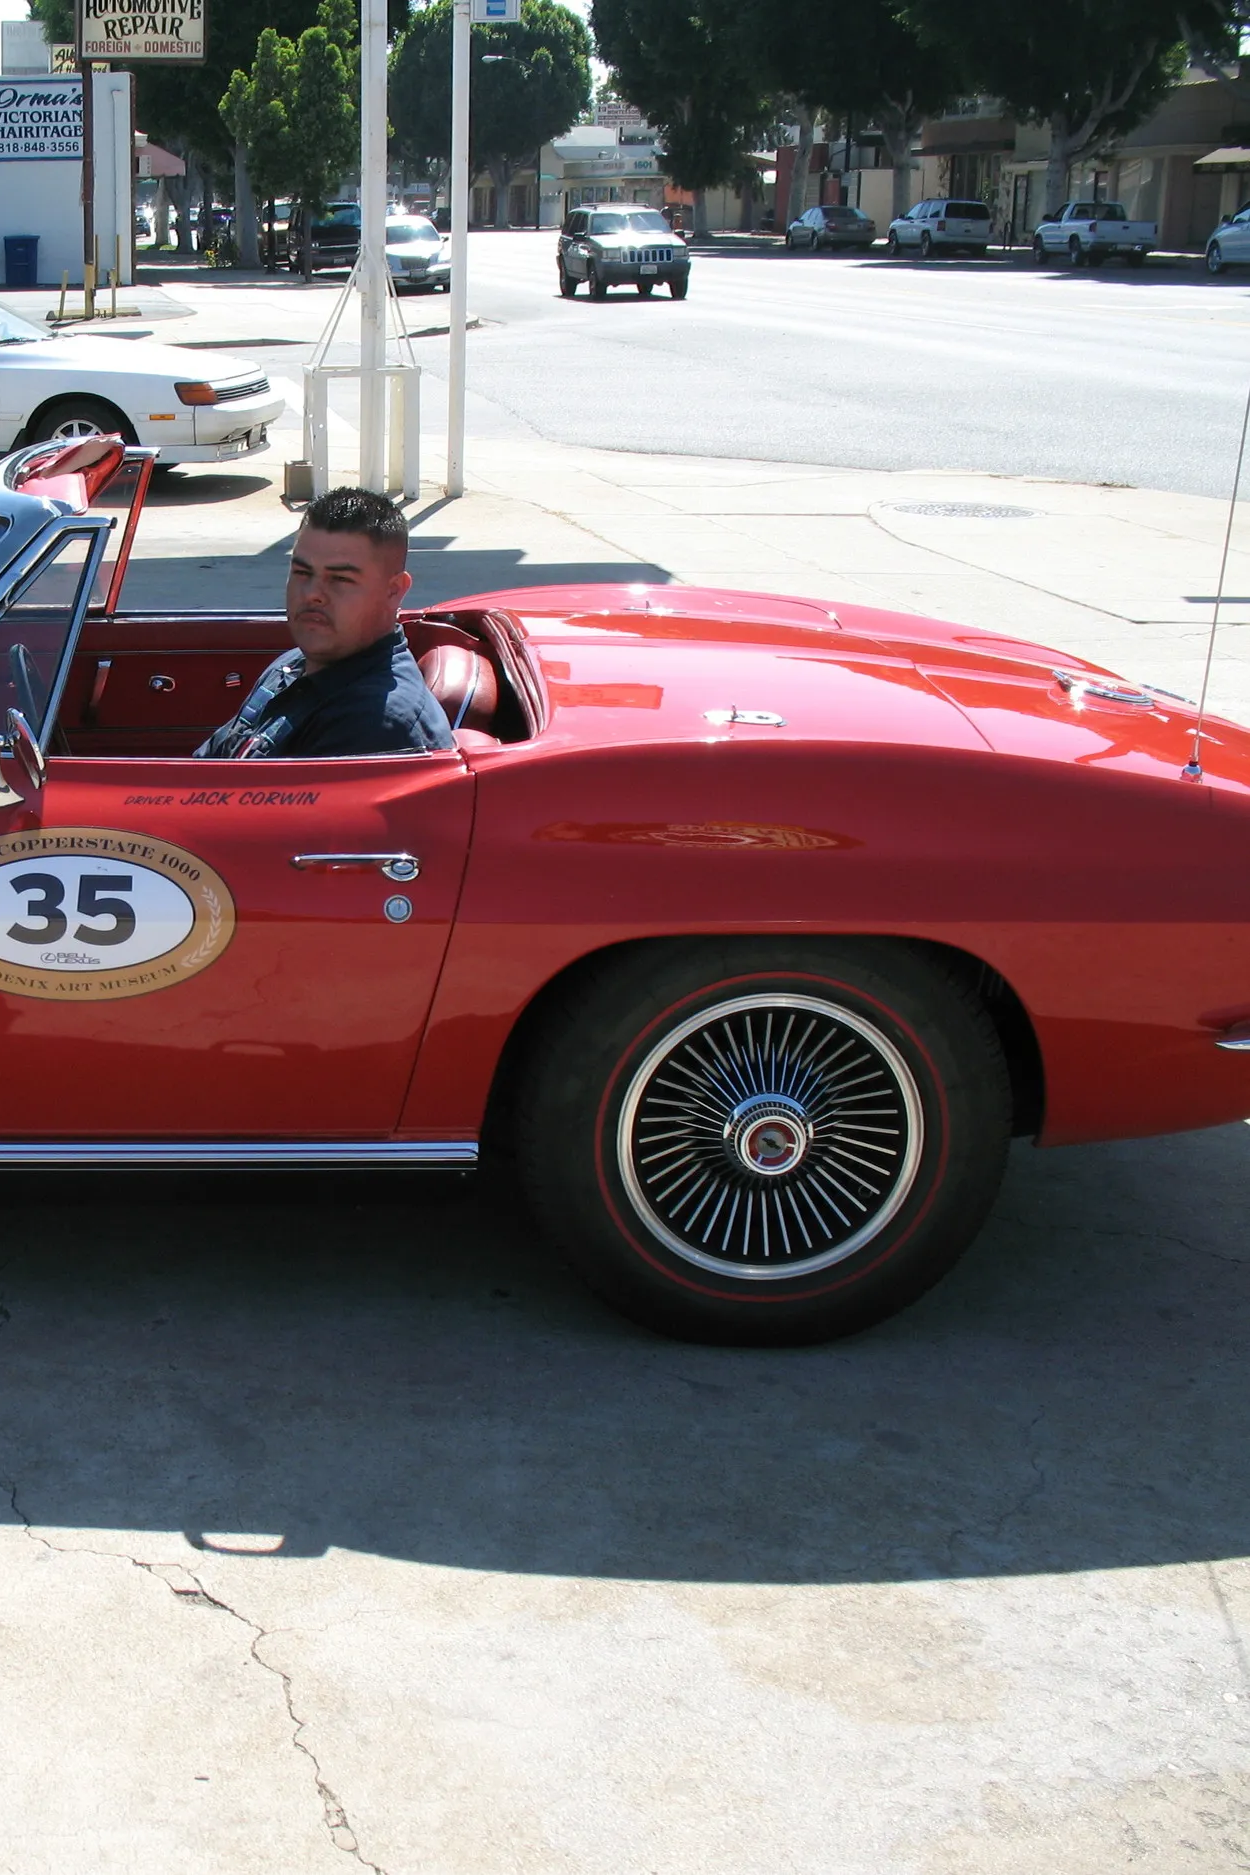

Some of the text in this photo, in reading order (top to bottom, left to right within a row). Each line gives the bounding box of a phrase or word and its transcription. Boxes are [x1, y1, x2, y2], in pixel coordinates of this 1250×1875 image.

[85, 0, 202, 20] AUTOMOTIVE
[103, 15, 187, 40] REPAIR
[85, 40, 202, 53] FOREIGN DOMESTIC
[124, 791, 321, 806] DRIVER JACK CORWIN
[158, 854, 203, 882] 1000
[6, 872, 137, 946] 35
[54, 980, 94, 993] ART
[99, 964, 178, 991] MUSEUM
